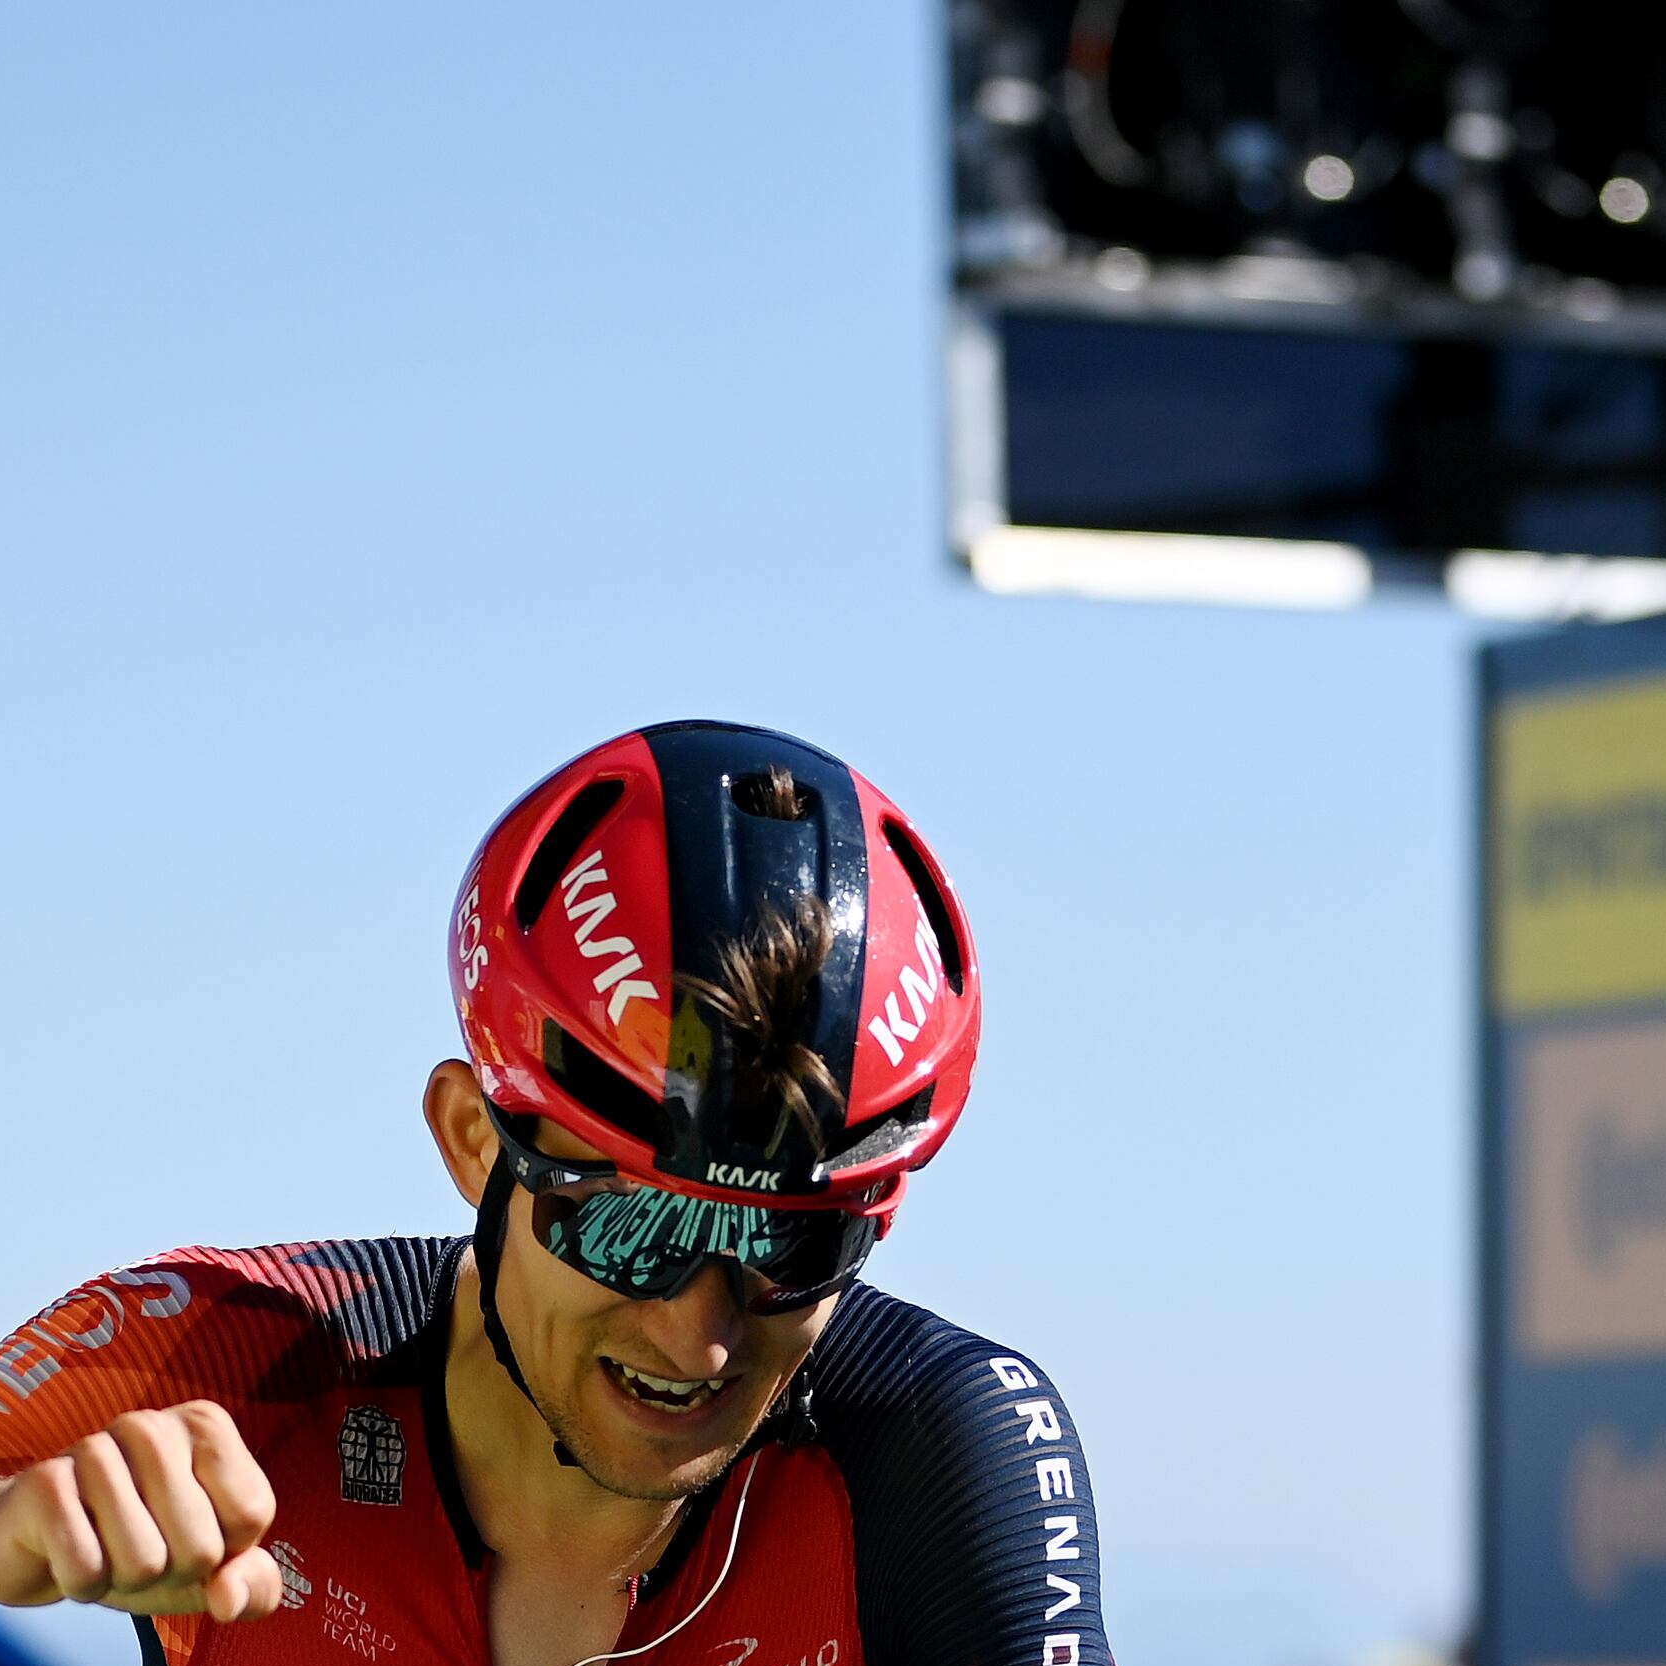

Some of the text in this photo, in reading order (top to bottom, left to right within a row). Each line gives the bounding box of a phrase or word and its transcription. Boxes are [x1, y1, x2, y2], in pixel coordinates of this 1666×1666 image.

[561, 850, 660, 1026] KASK
[705, 1161, 781, 1192] KASK
[327, 1577, 367, 1616] UCI
[321, 1615, 376, 1662] TEAM
[325, 1597, 397, 1652] WORLD
